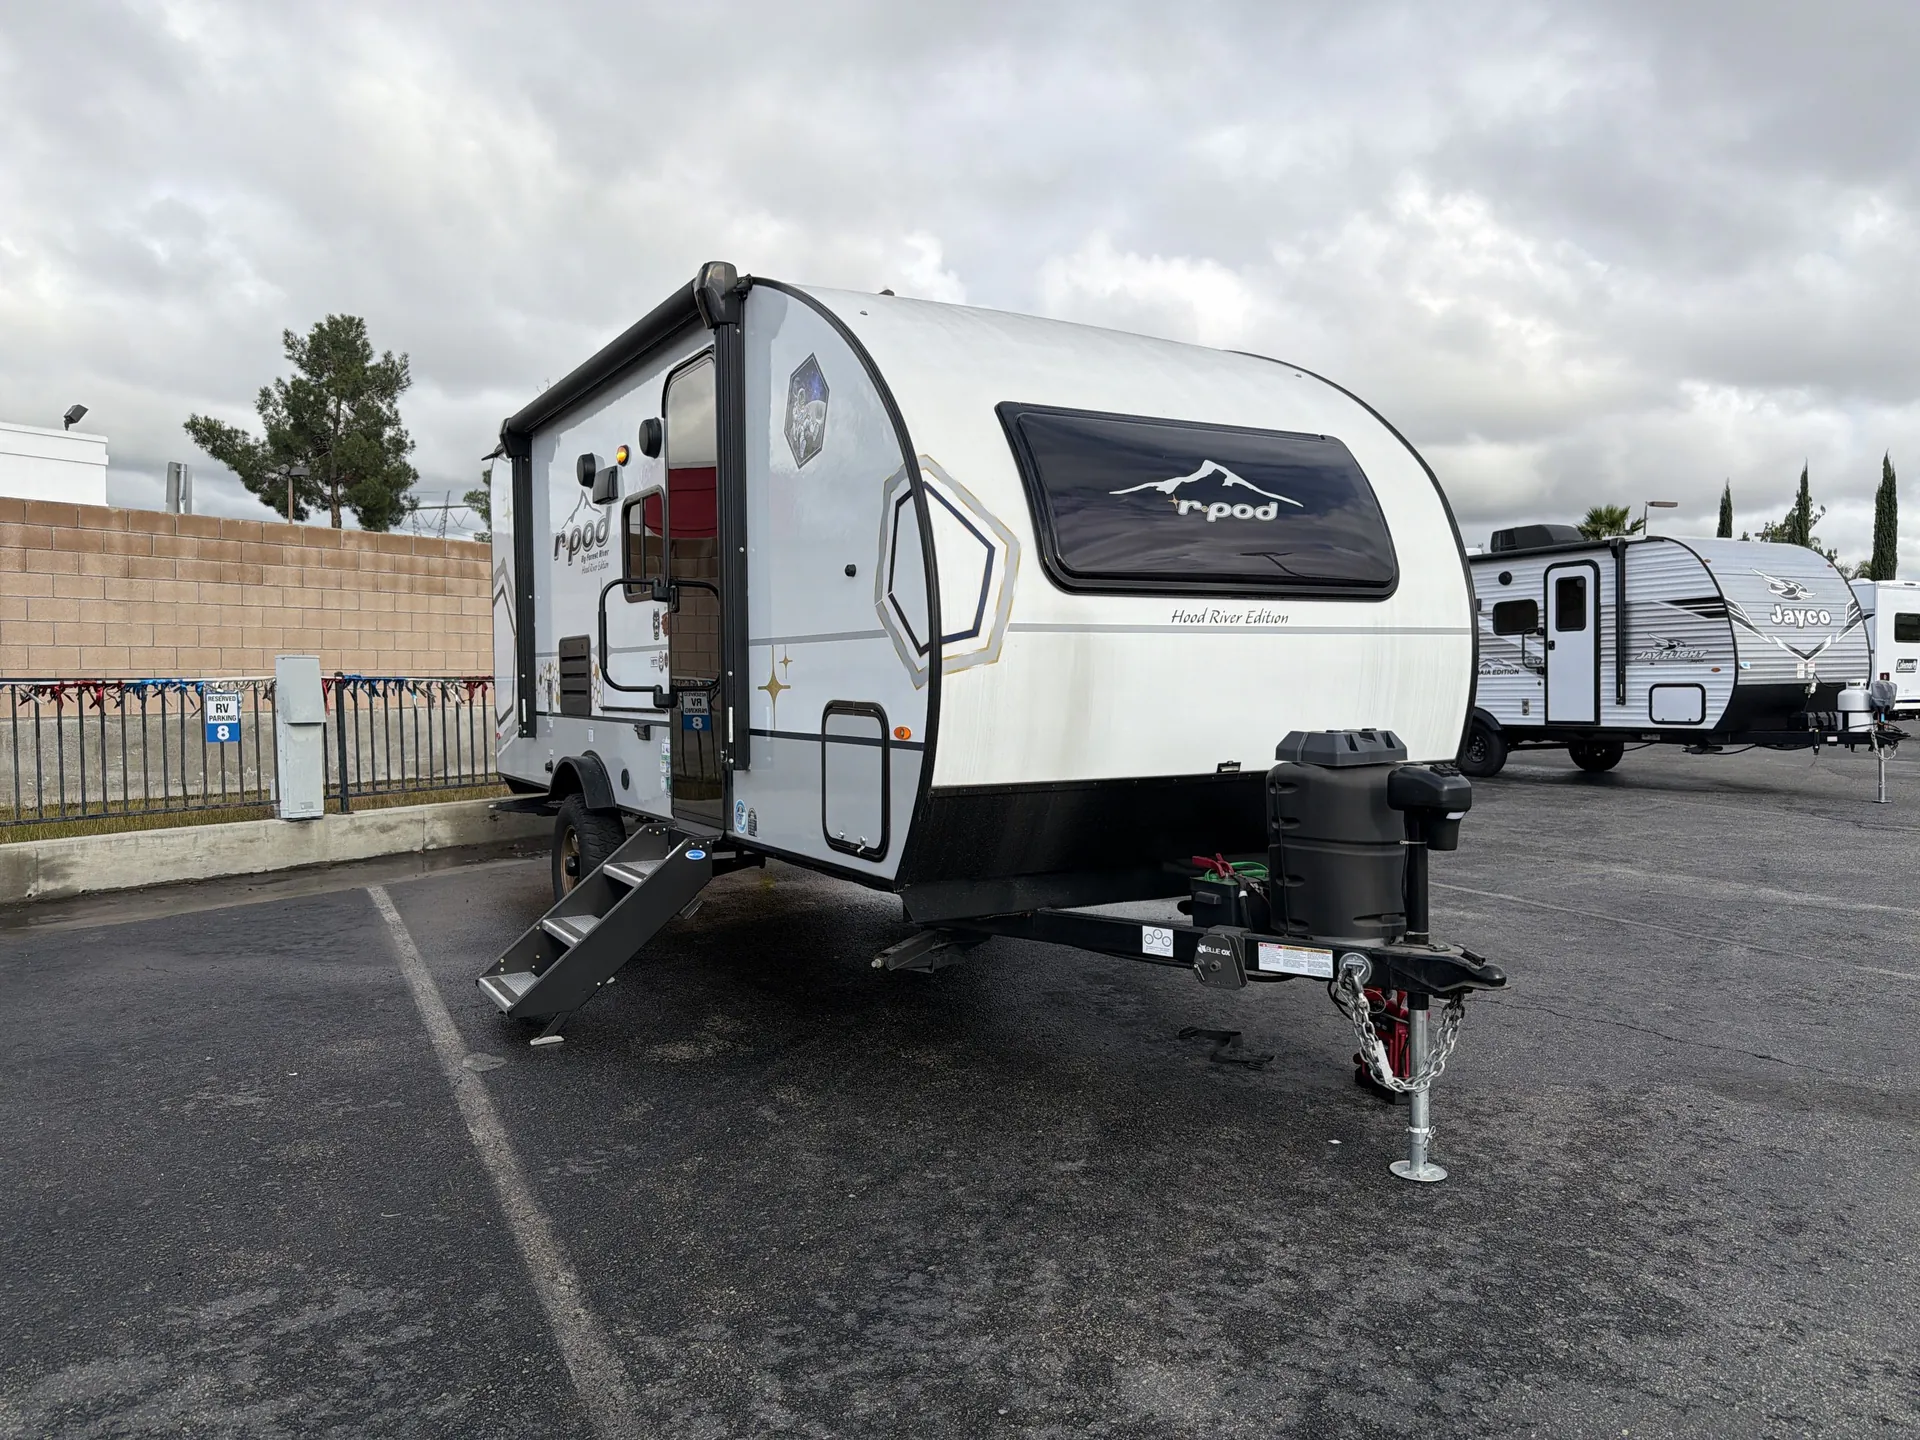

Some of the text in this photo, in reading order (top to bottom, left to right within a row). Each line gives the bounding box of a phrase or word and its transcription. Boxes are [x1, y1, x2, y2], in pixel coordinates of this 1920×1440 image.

[1171, 607, 1289, 624] Hood River Edition
[1770, 604, 1832, 629] Jayco
[1637, 649, 1709, 660] JAY FLIGHT
[1492, 668, 1520, 676] EDITION
[216, 703, 229, 713] RV
[217, 725, 230, 740] 8
[1206, 946, 1231, 957] BLUE OX
